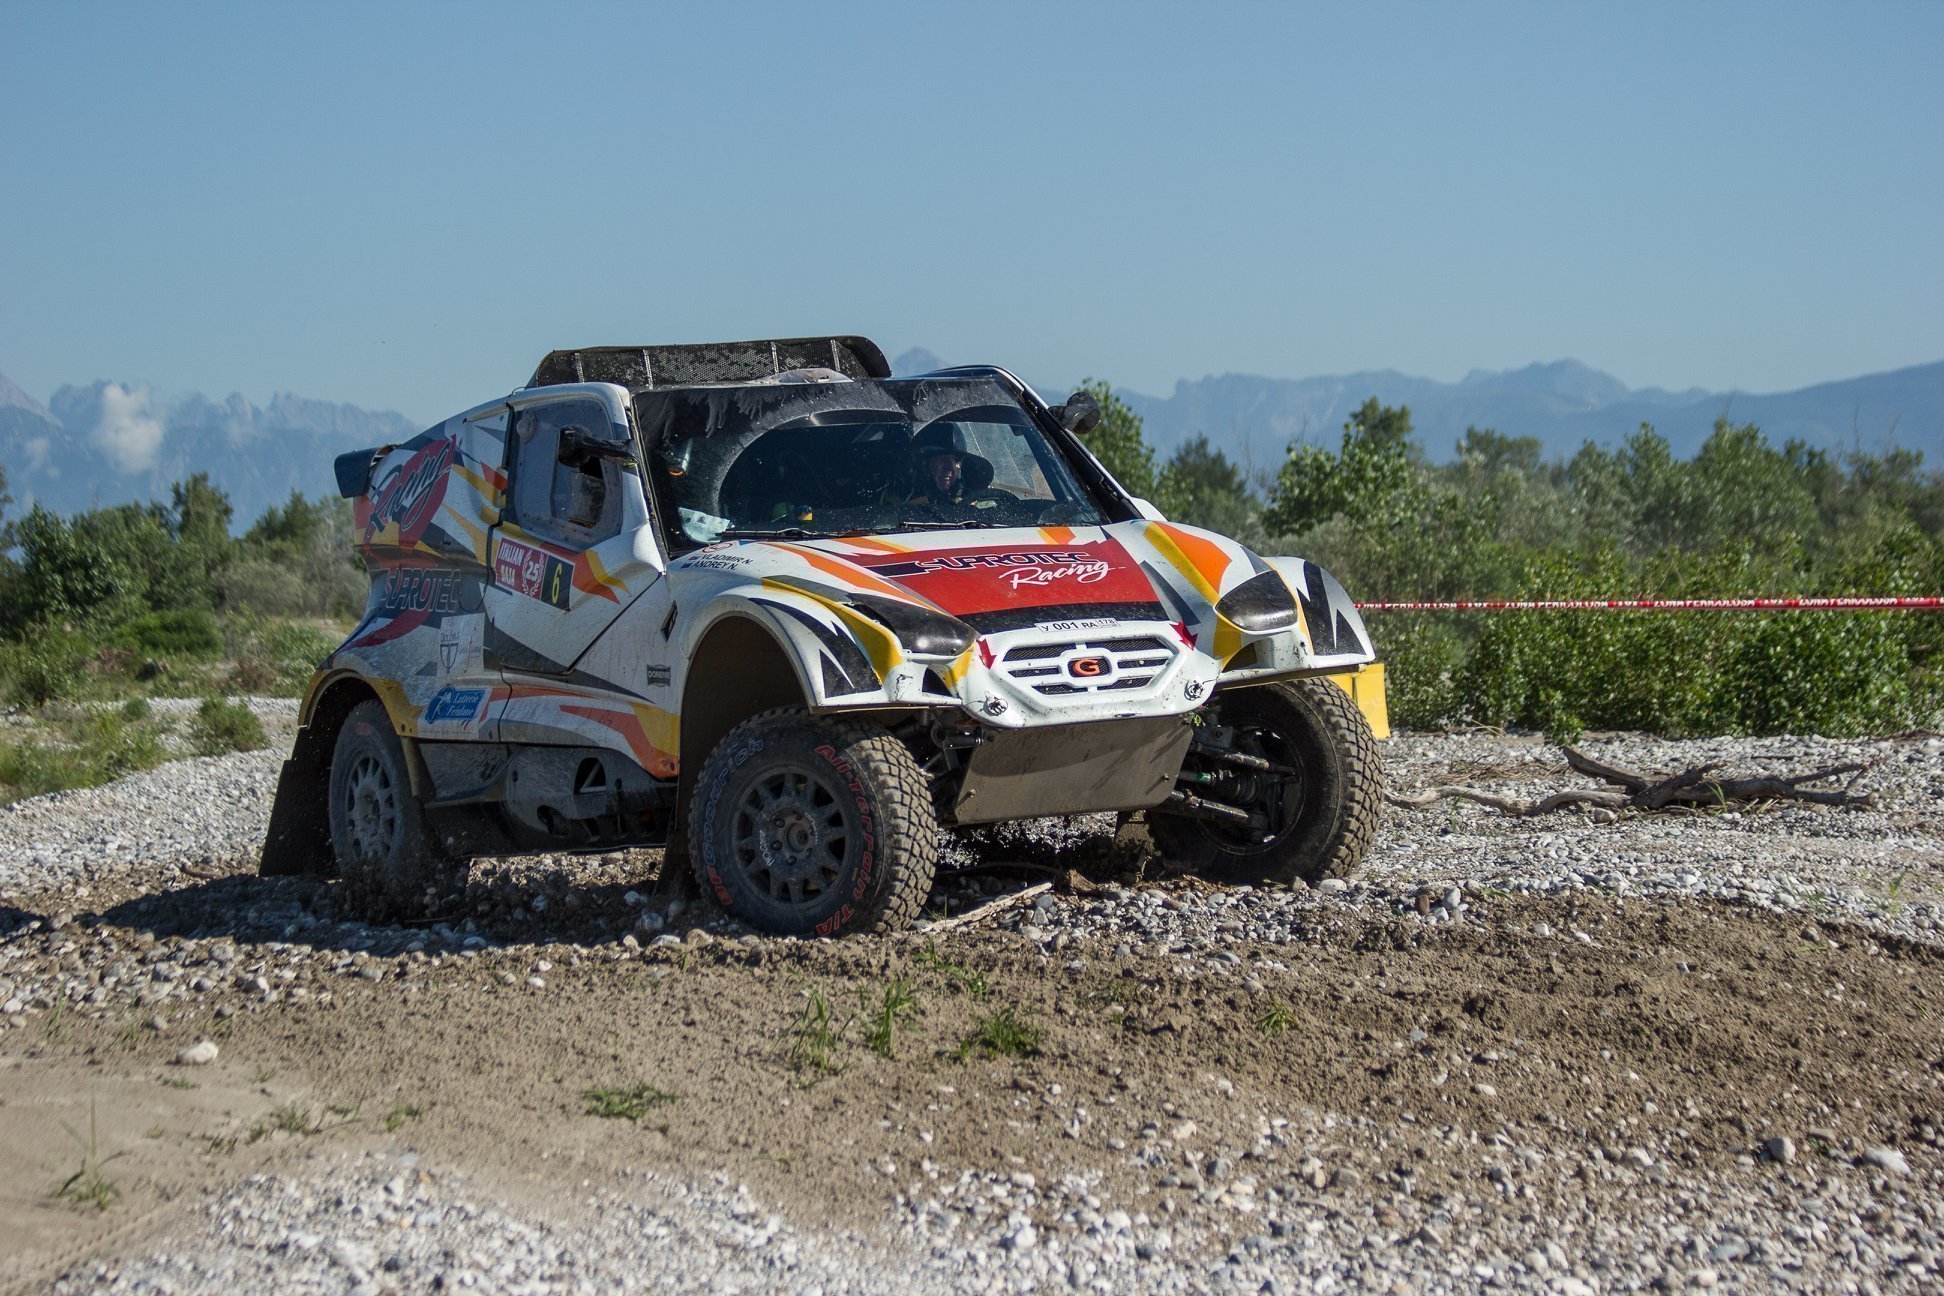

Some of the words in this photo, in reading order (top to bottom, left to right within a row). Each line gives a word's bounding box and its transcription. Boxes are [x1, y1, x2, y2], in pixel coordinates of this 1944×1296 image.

[364, 440, 453, 545] Racing
[498, 542, 525, 567] ITALIAN
[691, 560, 728, 569] ANDREY
[702, 553, 744, 563] VLADIMIR
[921, 552, 1099, 569] SUPROTEC
[525, 561, 540, 582] 25
[551, 562, 563, 605] 6
[999, 561, 1114, 590] Racing
[382, 567, 460, 613] SUPROTEC
[1052, 621, 1079, 631] 001
[814, 744, 874, 900] All-Terrain
[815, 903, 855, 936] T/A
